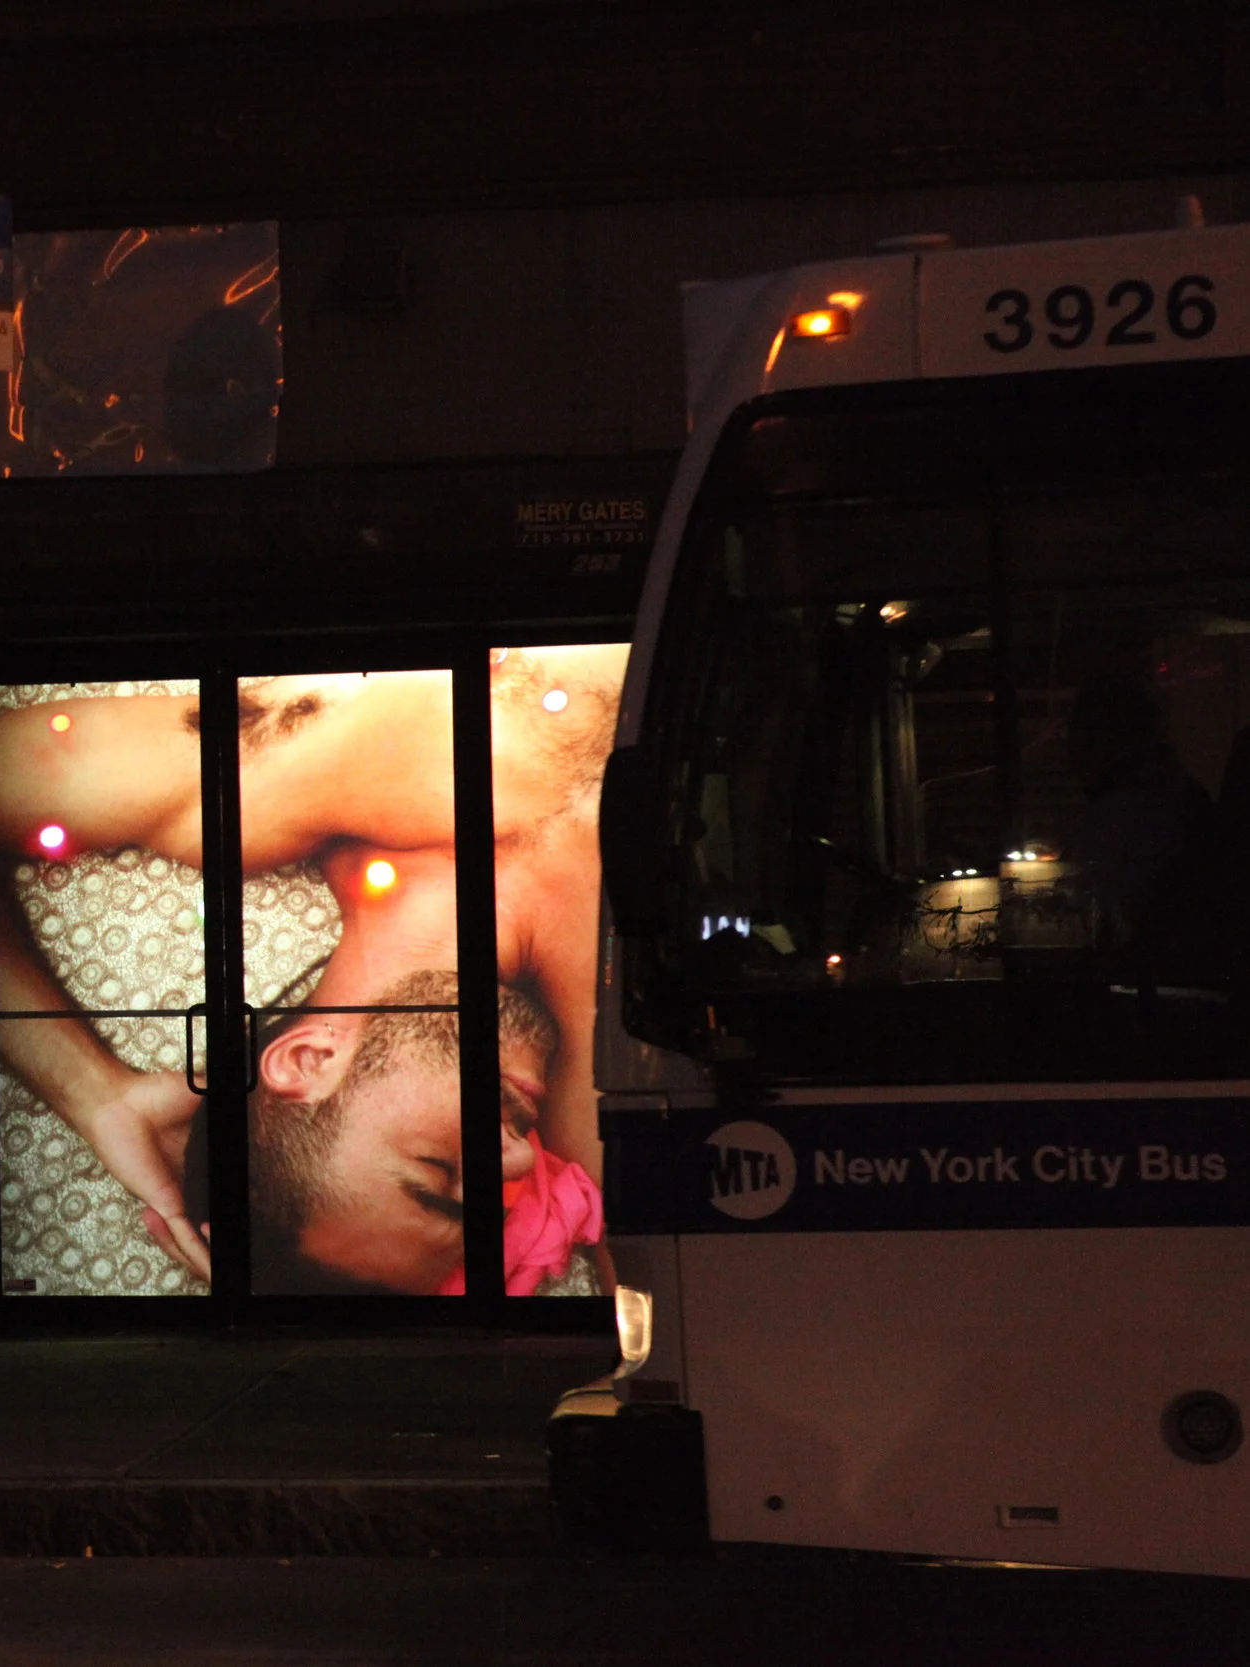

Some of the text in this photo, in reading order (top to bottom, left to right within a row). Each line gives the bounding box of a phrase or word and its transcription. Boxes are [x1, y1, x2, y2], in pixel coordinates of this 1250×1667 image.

[983, 275, 1217, 353] 3926
[517, 500, 645, 522] MERY GATES
[707, 1142, 1228, 1199] MTA New York City Bus
